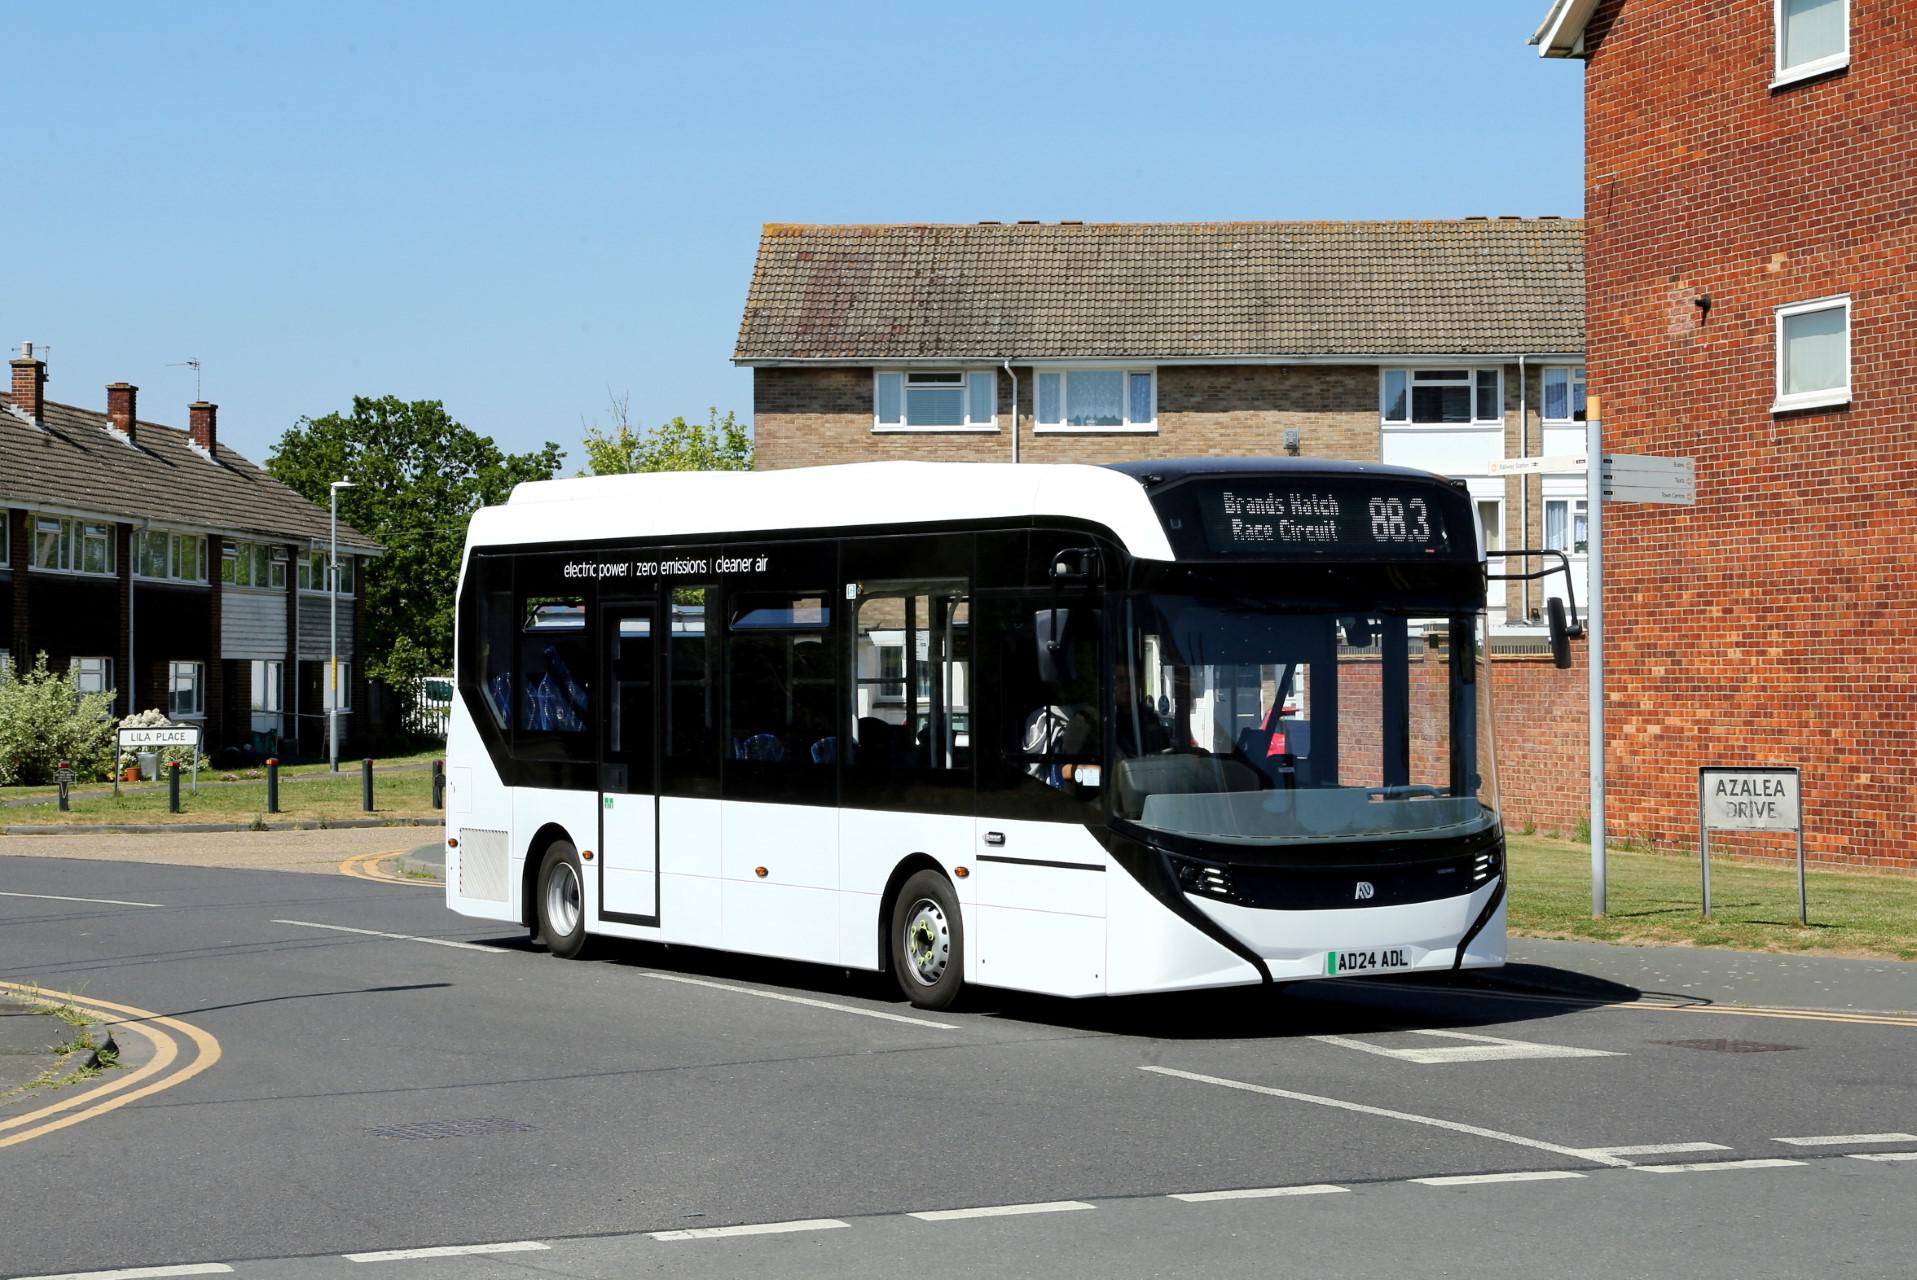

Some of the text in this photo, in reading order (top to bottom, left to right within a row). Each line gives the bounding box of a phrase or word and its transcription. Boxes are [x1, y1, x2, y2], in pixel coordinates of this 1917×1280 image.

[1223, 492, 1340, 516] Brands Hatch
[1231, 518, 1339, 542] Race Circuit
[563, 554, 768, 580] electric power zero emissions cleaner air
[130, 732, 185, 742] LILA PLACE
[1715, 779, 1786, 797] AZALEA
[1726, 800, 1777, 818] DRIVE
[1338, 949, 1408, 971] AD24 ADL
